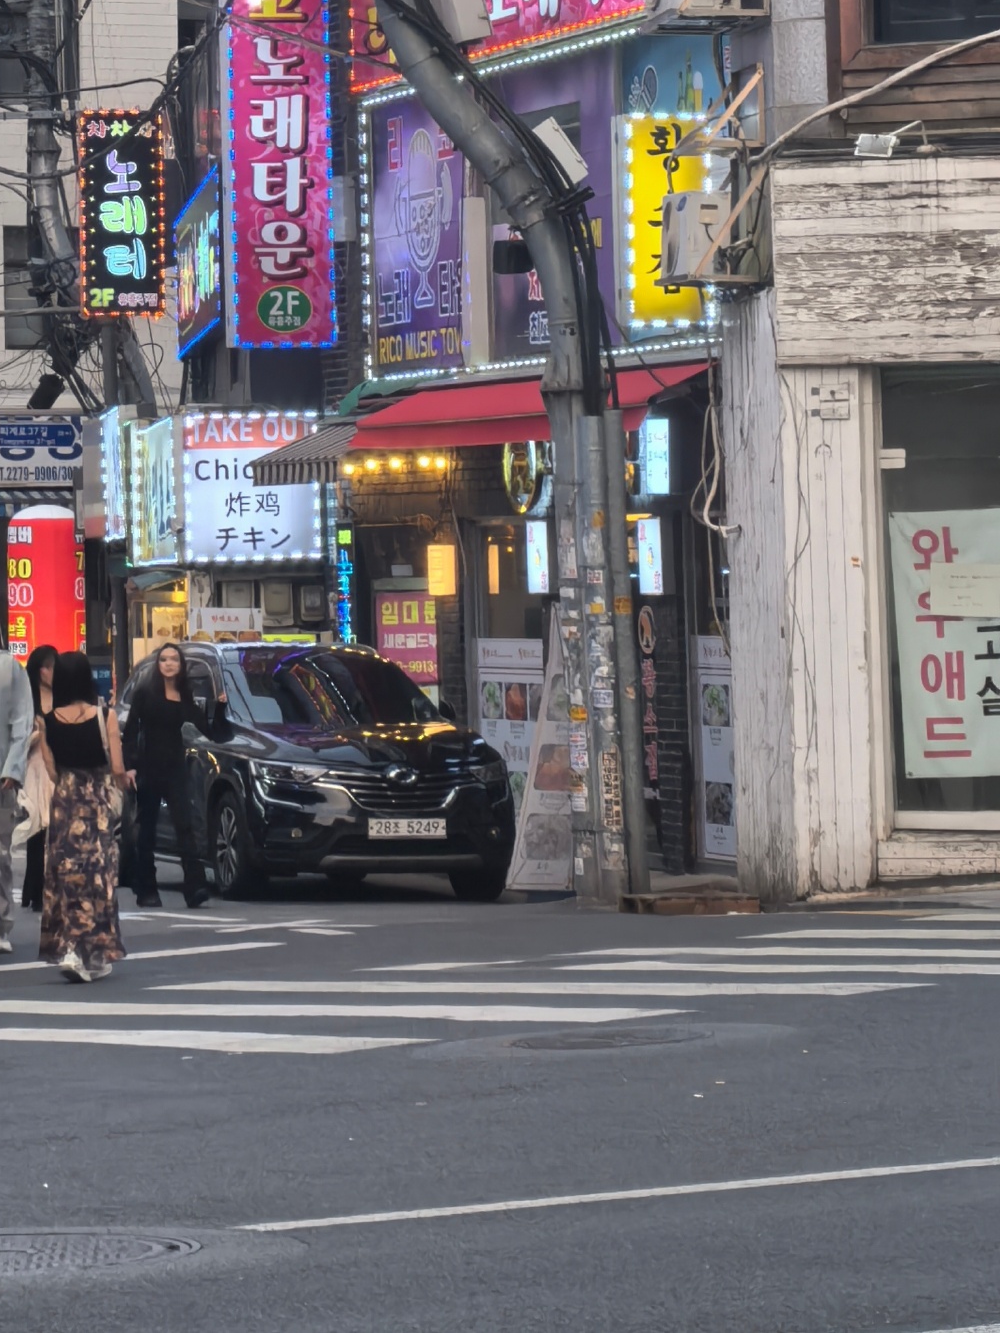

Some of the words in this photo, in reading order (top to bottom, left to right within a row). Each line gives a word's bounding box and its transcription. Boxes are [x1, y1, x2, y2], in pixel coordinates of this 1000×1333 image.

[250, 37, 309, 275] 노래타운
[99, 149, 147, 279] 노래터
[89, 288, 115, 307] 2F
[269, 291, 299, 316] 2F
[379, 335, 402, 364] RICO
[406, 330, 437, 358] MUSIC
[192, 419, 255, 443] TAKE
[0, 466, 76, 482] T.2279-0906/30
[225, 491, 280, 517] 炸鸡
[216, 527, 291, 551] チキン
[407, 820, 442, 834] 5249
